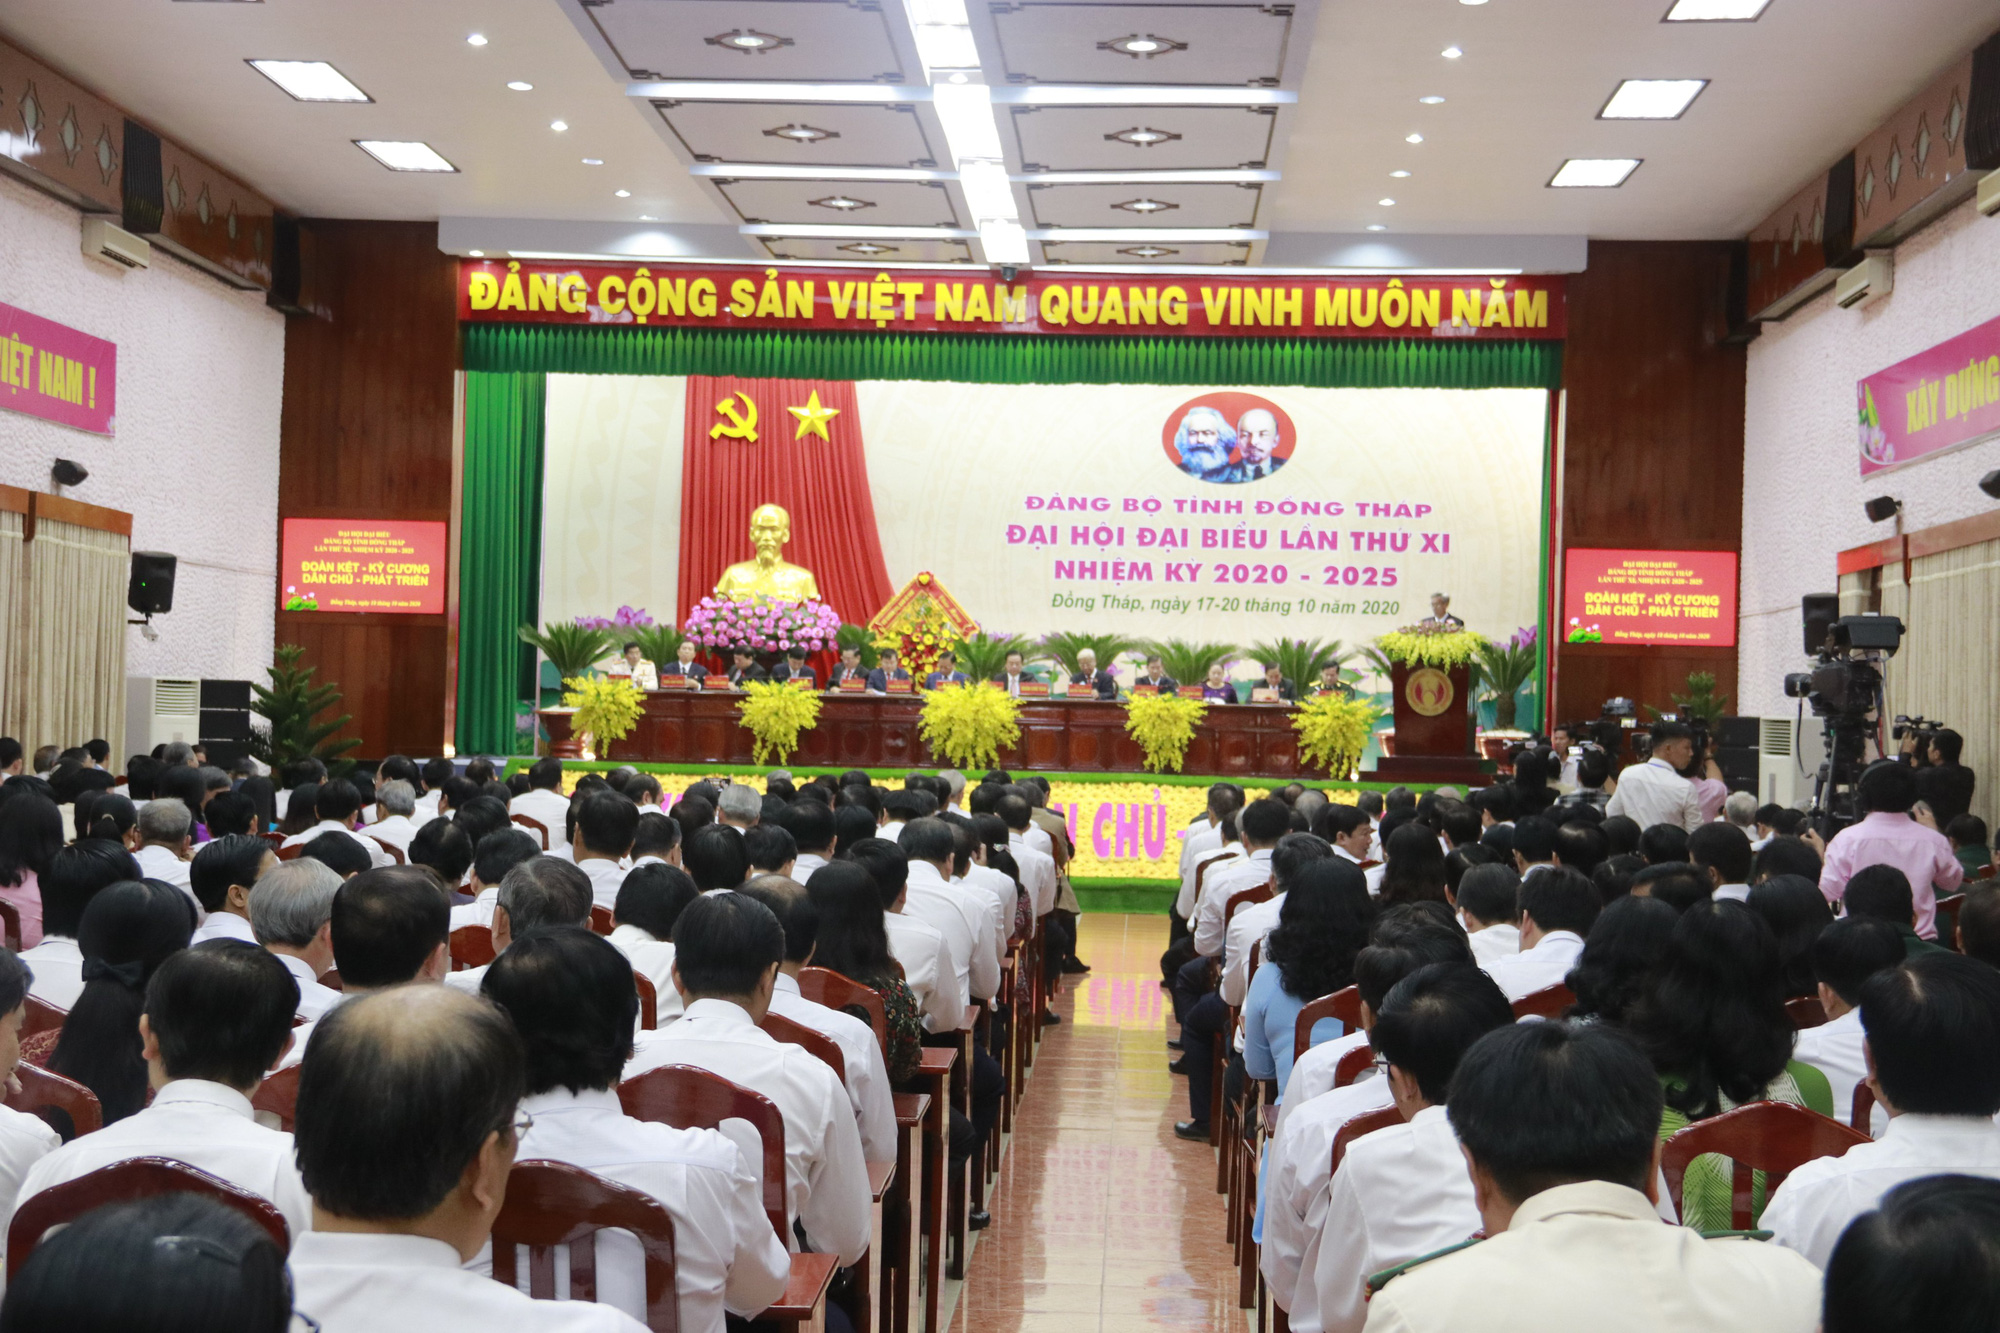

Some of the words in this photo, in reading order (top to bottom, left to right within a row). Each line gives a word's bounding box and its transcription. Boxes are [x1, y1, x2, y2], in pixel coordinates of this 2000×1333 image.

[469, 260, 587, 314] ĐẢNG
[598, 267, 717, 324] CỘNG
[729, 267, 815, 319] SẢN
[828, 272, 924, 328] VIỆT
[935, 282, 1027, 323] NAM
[1040, 284, 1189, 327] QUANG
[1200, 286, 1303, 327] VINH
[1314, 278, 1440, 328] MUÔN
[1451, 278, 1547, 328] NĂM
[0, 332, 34, 395] IỆT
[39, 349, 83, 406] NAM
[1906, 378, 1940, 435] XÂY
[1945, 355, 2000, 422] DỰNG
[1024, 492, 1111, 512] ĐẢNG
[1123, 495, 1162, 517] BỘ
[1173, 495, 1243, 514] TỈNH
[1254, 496, 1345, 516] ĐỒNG
[1355, 499, 1432, 518] THÁP
[1006, 524, 1058, 550] ĐẠI
[1071, 521, 1125, 552] HỘI
[1136, 527, 1189, 553] ĐẠI
[1201, 521, 1267, 550] BIỂU
[1280, 523, 1338, 551] LẦN
[1350, 528, 1412, 553] THỨ
[1420, 532, 1450, 553] XI
[1054, 557, 1153, 586] NHIỆM
[1165, 558, 1203, 583] KỲ
[1213, 563, 1288, 585] 2020
[1323, 565, 1398, 587] 2025
[1051, 590, 1096, 613] Đồng
[1101, 592, 1145, 615] Tháp,
[1150, 594, 1190, 617] ngày
[1197, 595, 1239, 613] 17-20
[1244, 596, 1292, 618] tháng
[1297, 597, 1316, 615] 10
[1321, 598, 1356, 616] năm
[1360, 598, 1401, 617] 2020
[1092, 788, 1167, 859] CHỦ
